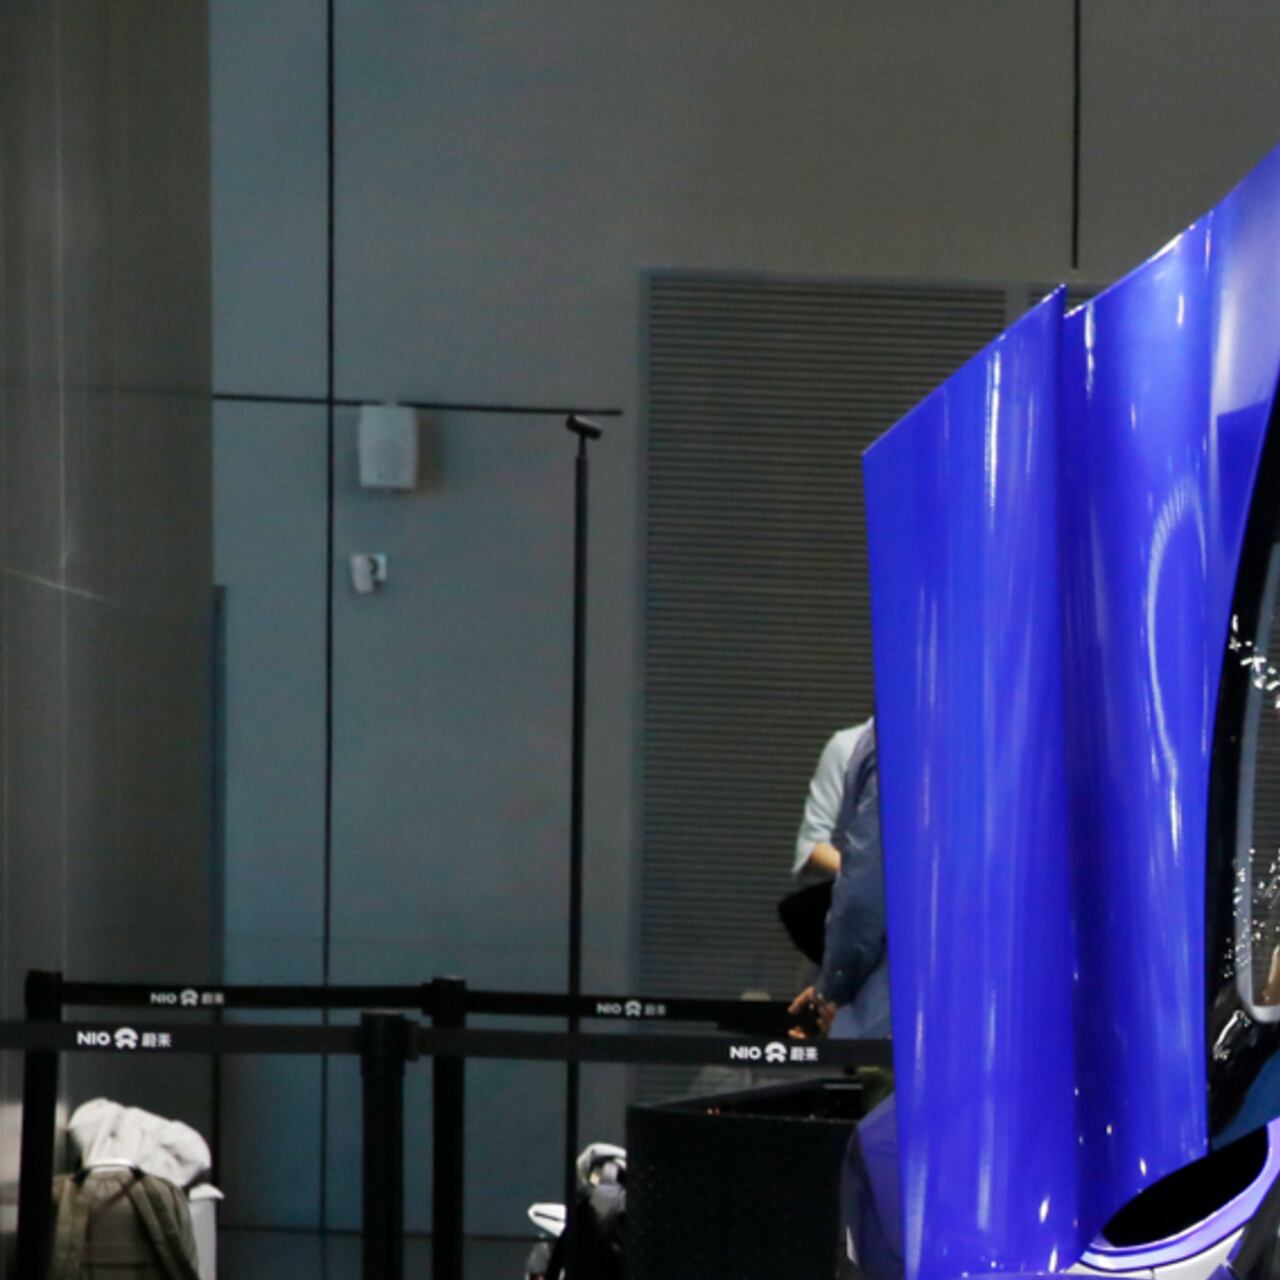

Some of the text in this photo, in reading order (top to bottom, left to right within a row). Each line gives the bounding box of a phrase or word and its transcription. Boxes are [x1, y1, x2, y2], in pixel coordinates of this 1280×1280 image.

[150, 992, 177, 1004] NIO
[77, 1031, 111, 1046] NIO
[729, 1046, 762, 1060] NIO
